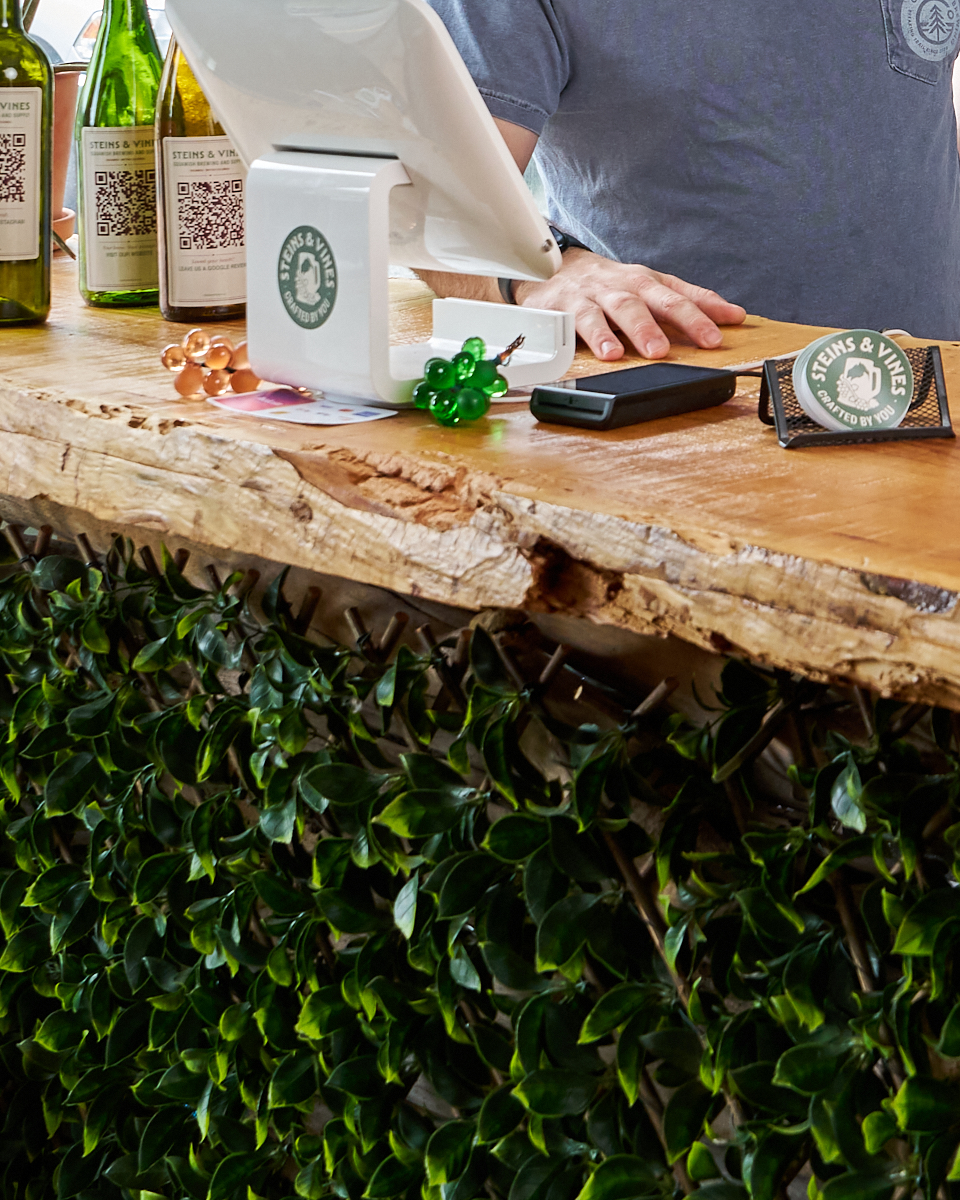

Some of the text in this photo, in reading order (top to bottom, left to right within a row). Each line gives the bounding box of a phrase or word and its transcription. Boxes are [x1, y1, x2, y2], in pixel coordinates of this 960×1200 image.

[0, 102, 30, 110] VINES
[90, 141, 120, 149] STEINS
[133, 140, 154, 148] VIN
[172, 151, 204, 159] STEINS
[218, 149, 239, 157] VIN
[280, 232, 335, 288] STEINS & VINES
[284, 291, 330, 323] CRAFTED BY YOU
[811, 336, 906, 396] STEINS & VINES
[817, 389, 896, 426] CRAFTED BY YOU
